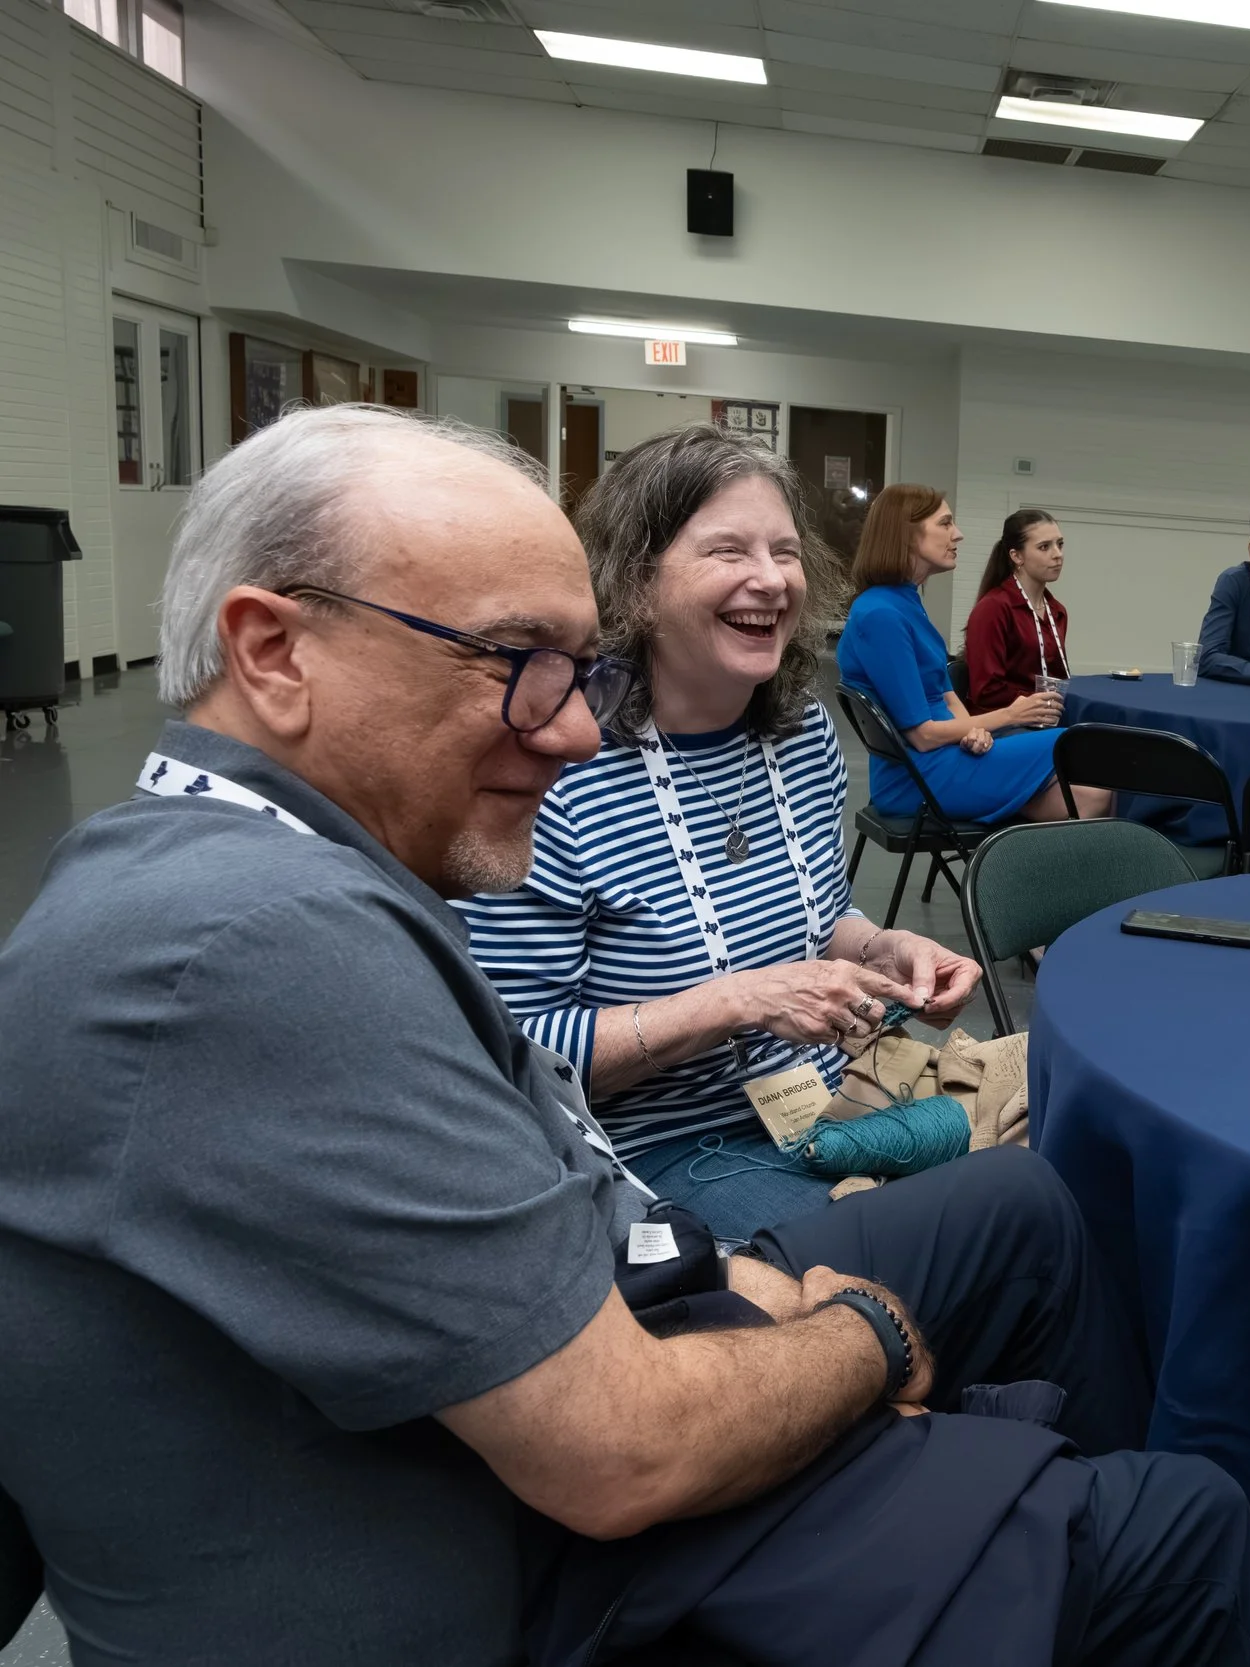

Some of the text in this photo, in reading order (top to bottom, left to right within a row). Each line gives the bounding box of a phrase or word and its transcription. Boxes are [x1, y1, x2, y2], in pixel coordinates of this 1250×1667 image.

[653, 342, 679, 363] EXIT
[758, 1078, 818, 1106] DIANA BRIDGES
